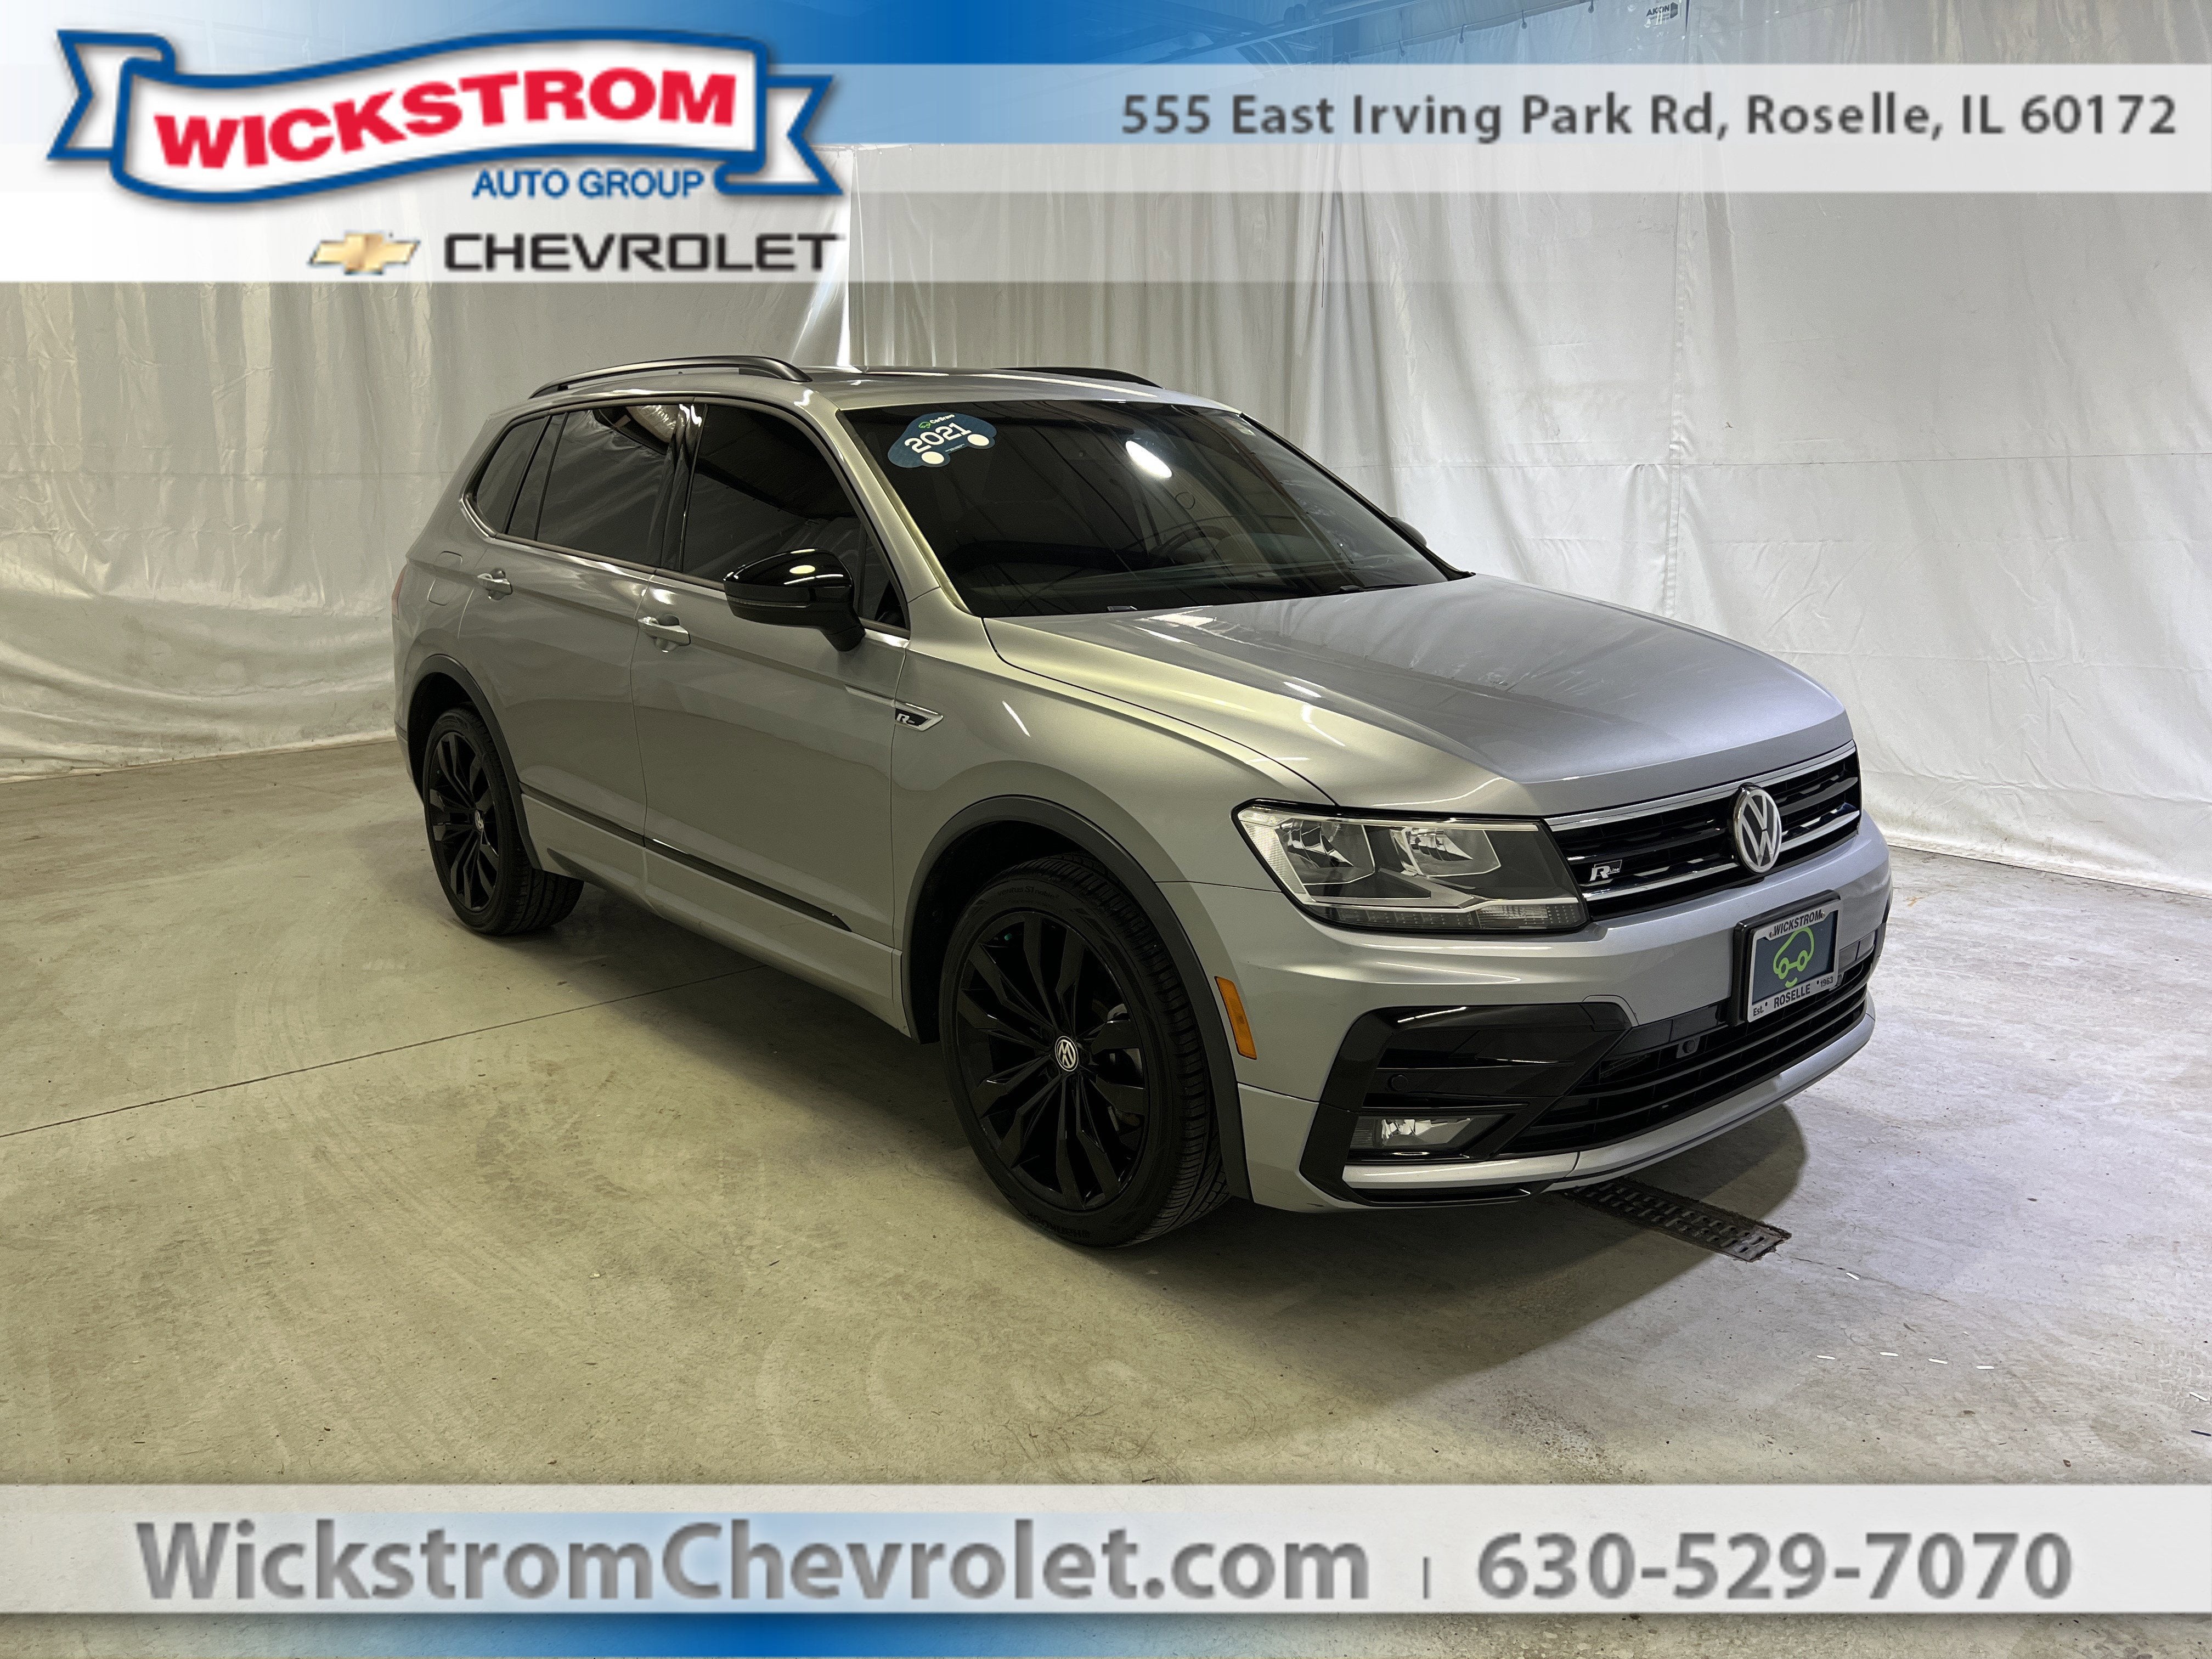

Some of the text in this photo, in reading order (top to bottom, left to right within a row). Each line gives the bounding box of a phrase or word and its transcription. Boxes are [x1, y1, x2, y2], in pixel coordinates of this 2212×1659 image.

[905, 422, 972, 453] 2021
[1774, 909, 1822, 936] WICKSTROM
[1753, 977, 1833, 1017] Est. ROSELLE 1963
